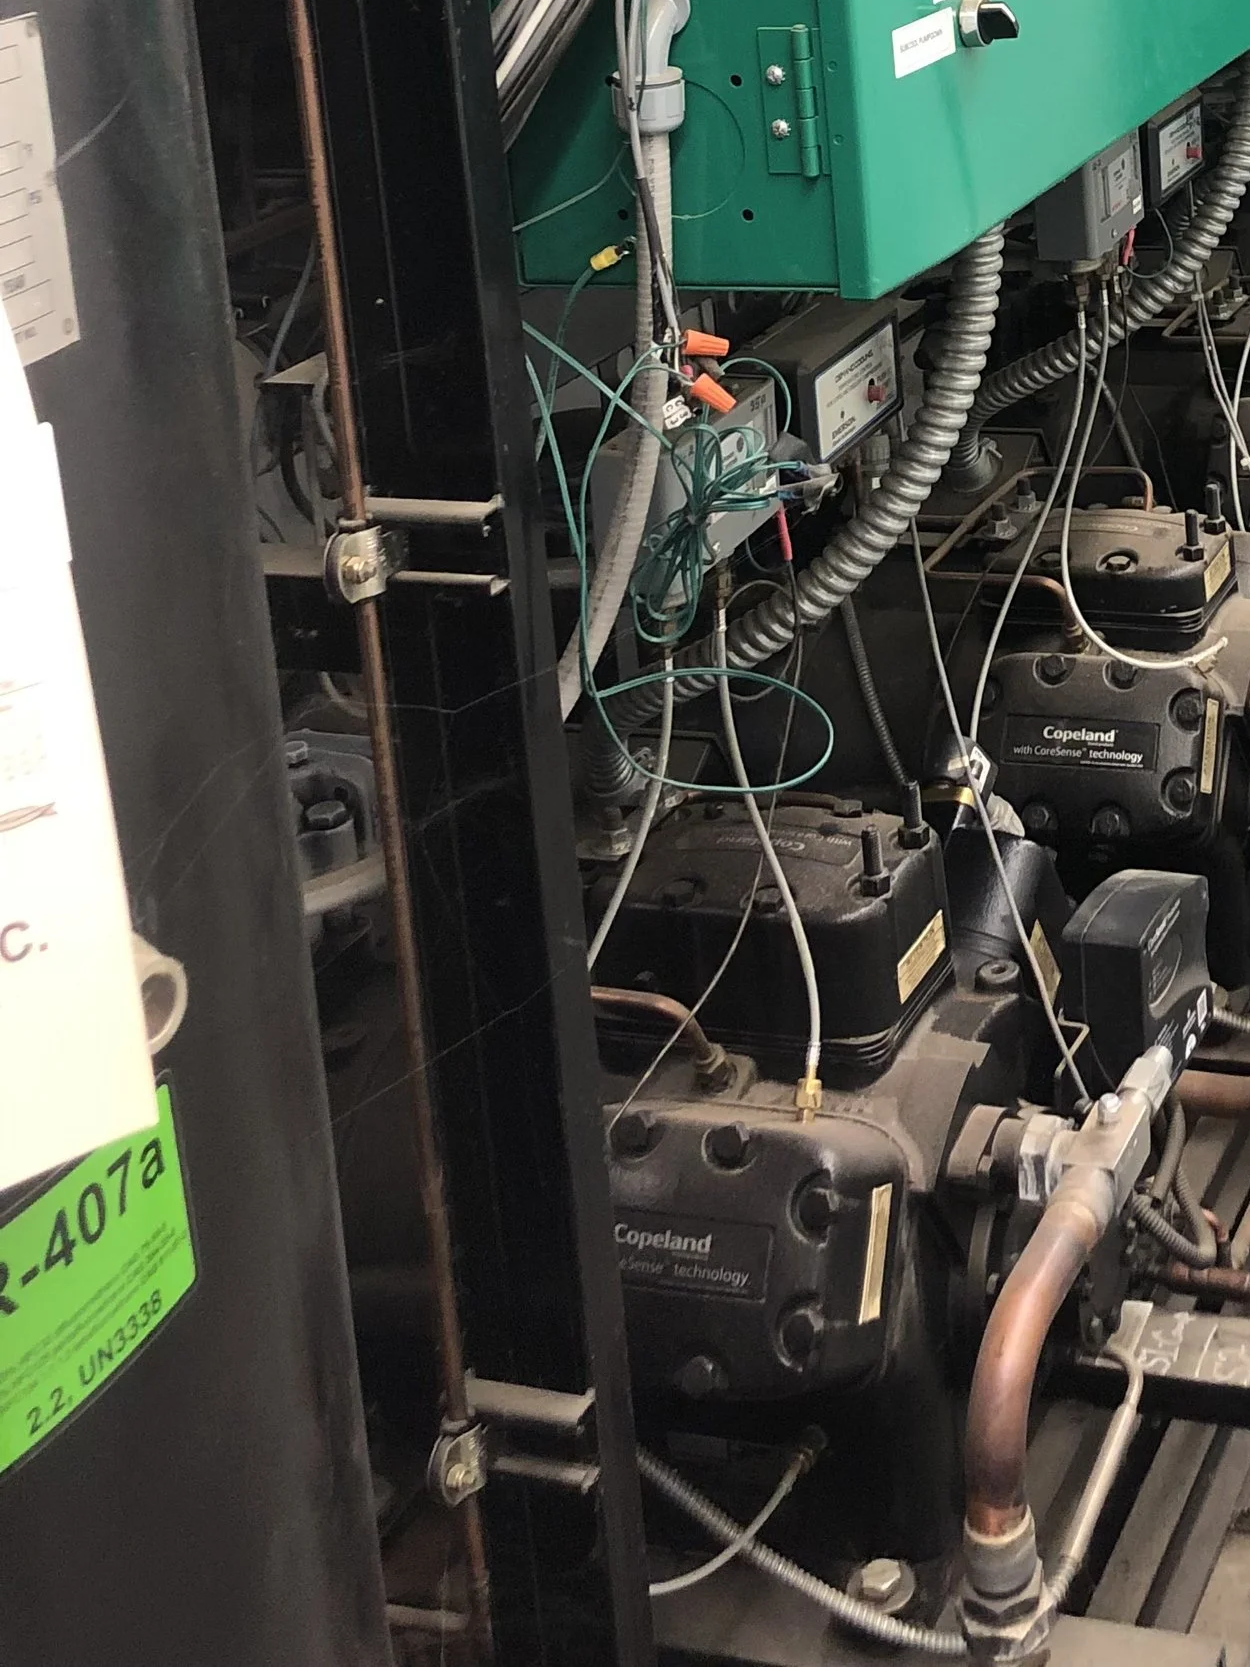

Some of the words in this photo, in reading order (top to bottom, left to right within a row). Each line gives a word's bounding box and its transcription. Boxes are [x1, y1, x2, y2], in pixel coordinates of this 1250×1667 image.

[1042, 725, 1119, 744] Copeland
[1013, 744, 1033, 755] with
[1089, 748, 1143, 764] technology
[614, 1222, 713, 1254] Copeland
[674, 1262, 750, 1288] technology
[78, 1289, 162, 1386] UN3338
